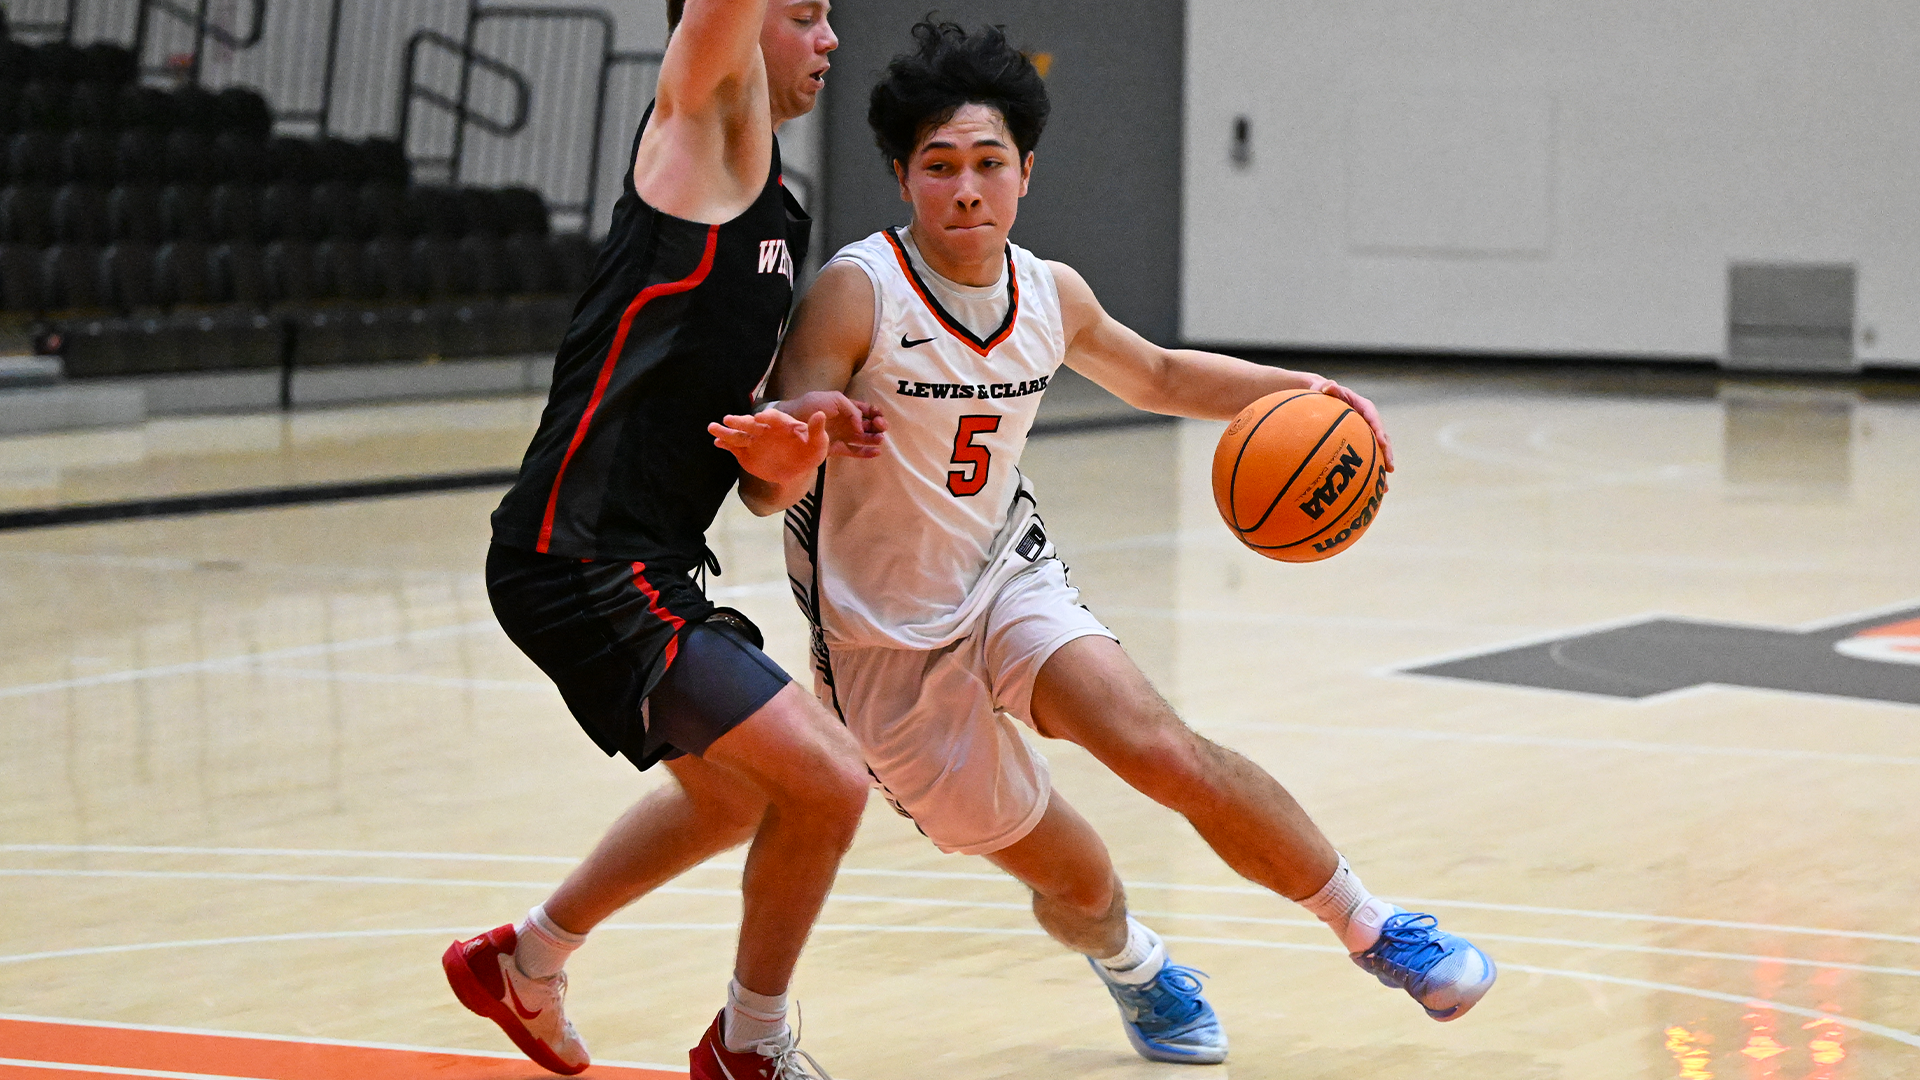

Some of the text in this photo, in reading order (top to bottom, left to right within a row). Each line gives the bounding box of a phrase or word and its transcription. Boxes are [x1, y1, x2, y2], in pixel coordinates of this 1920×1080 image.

[897, 375, 1049, 399] LEWIS & CLARK
[946, 414, 1002, 498] 5
[1299, 443, 1364, 521] NCAA
[1311, 465, 1387, 553] Wilson
